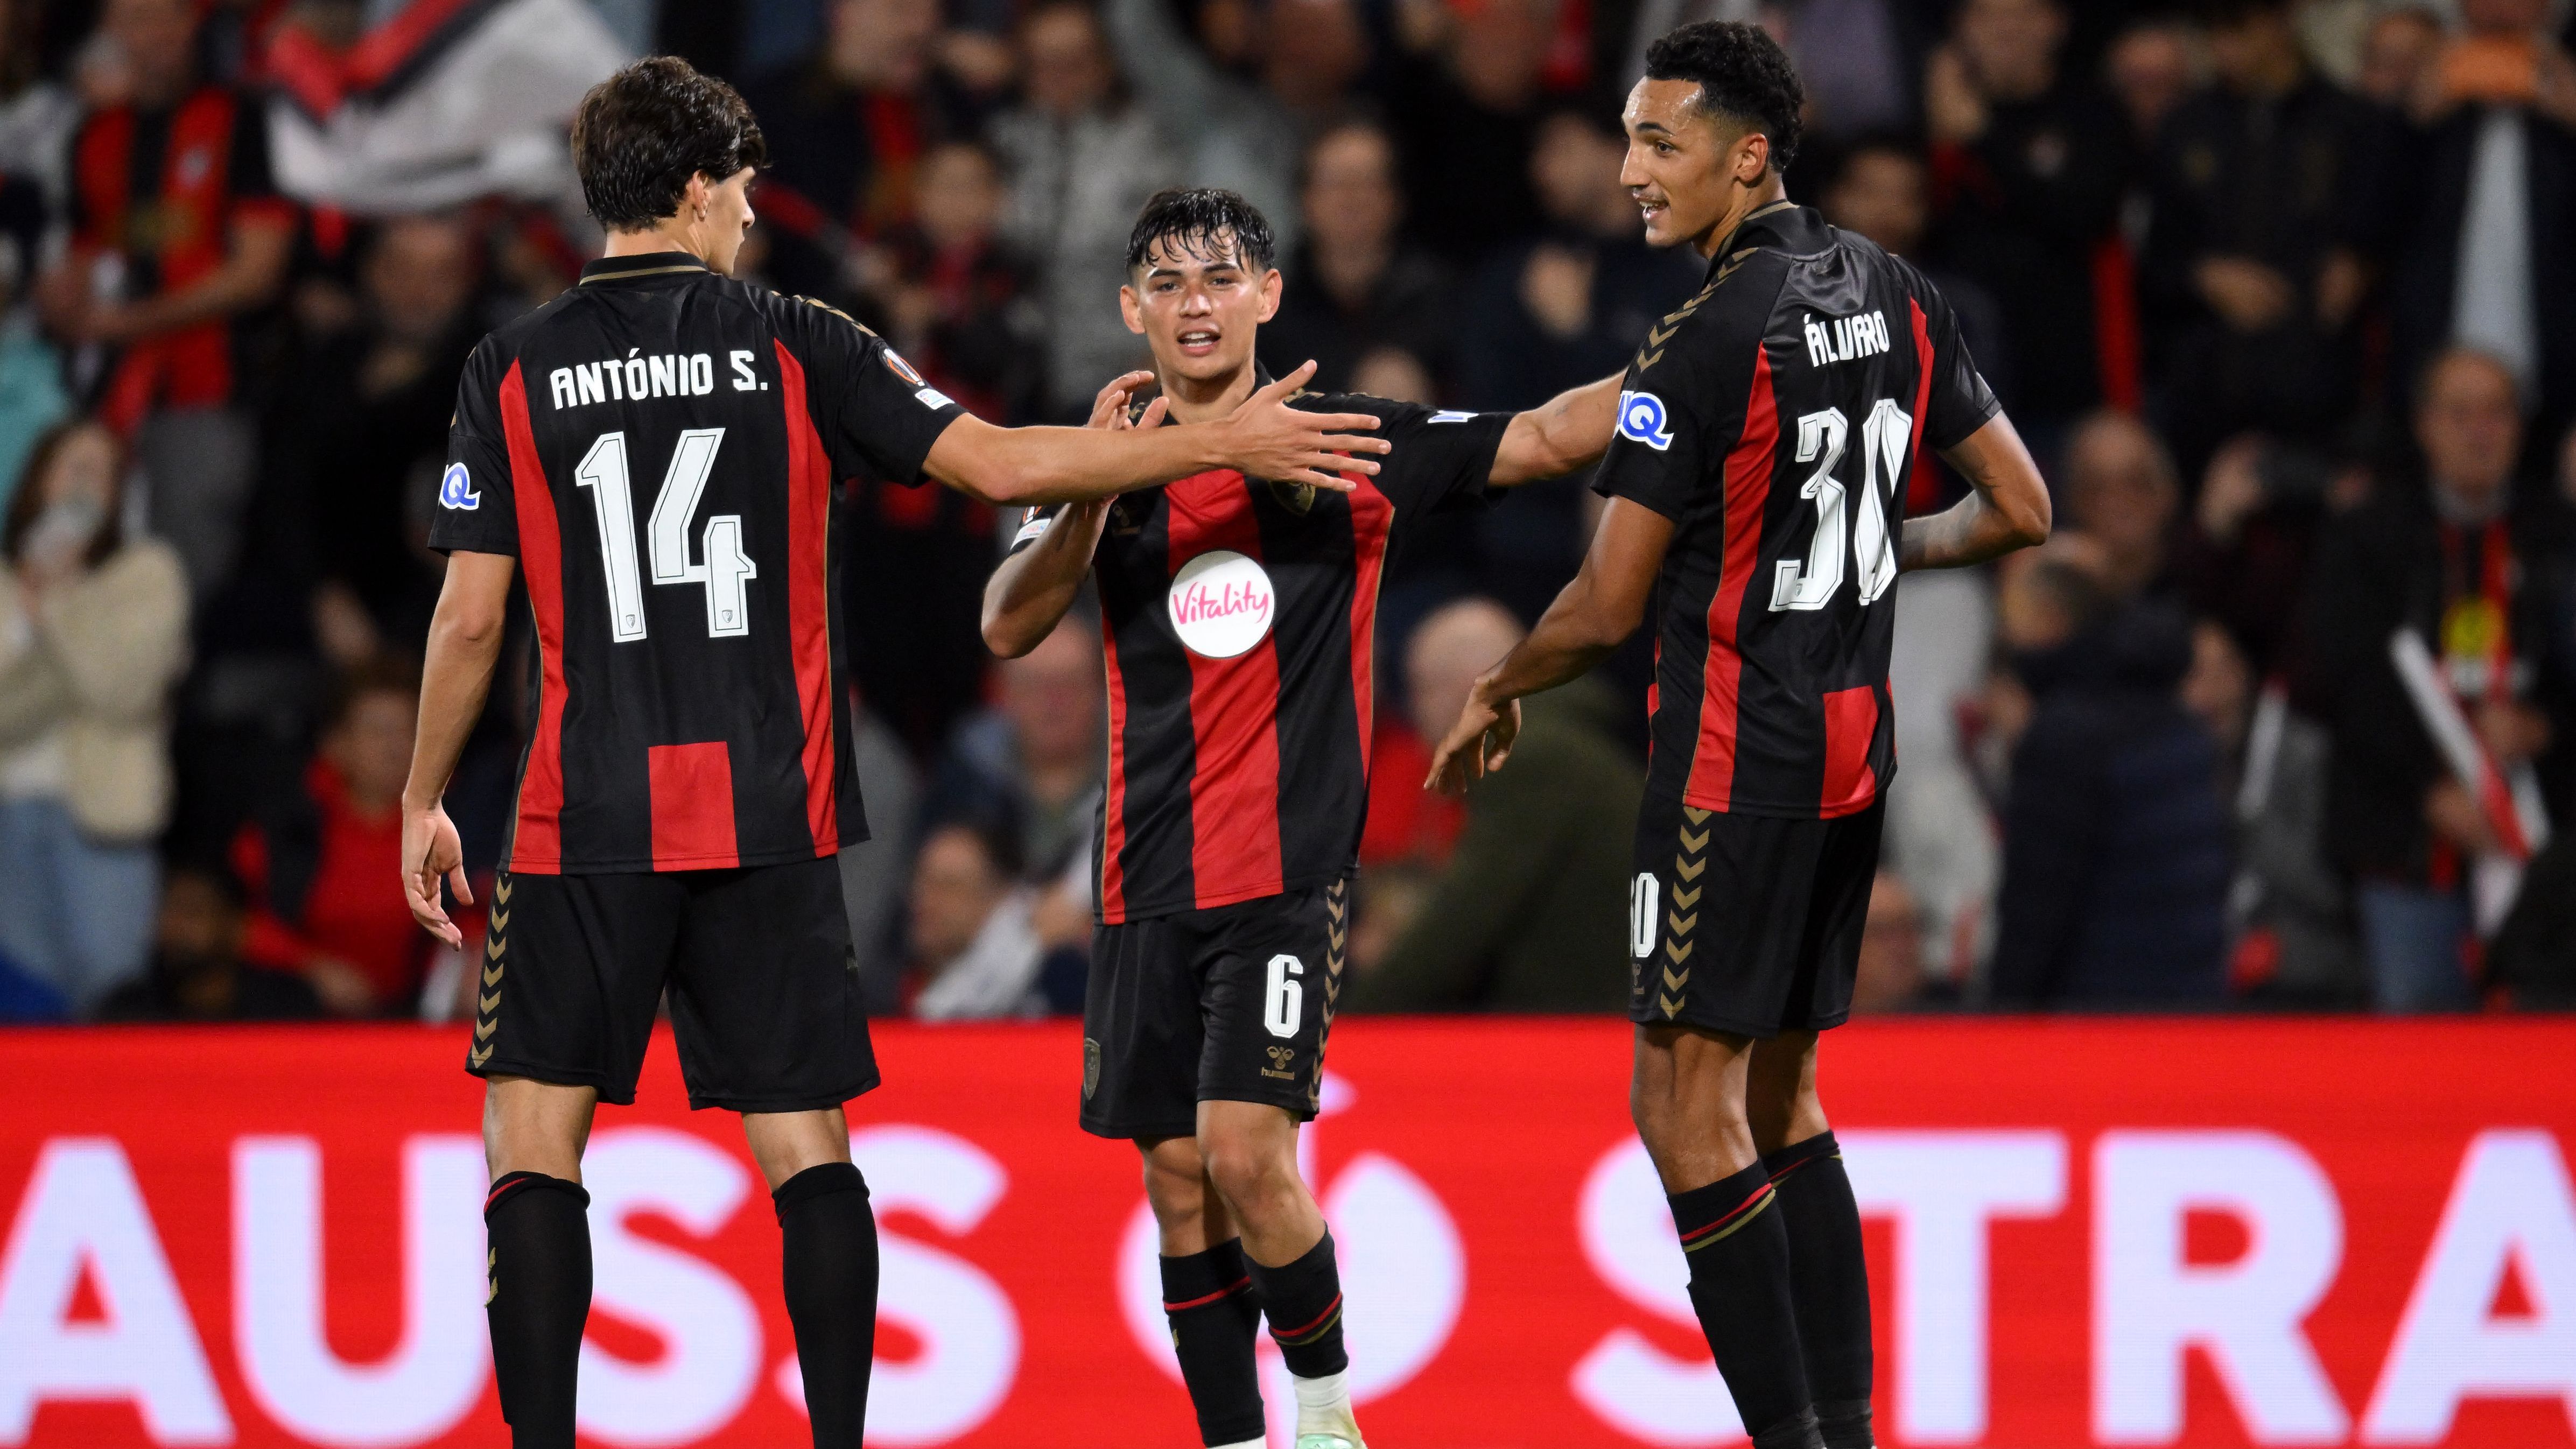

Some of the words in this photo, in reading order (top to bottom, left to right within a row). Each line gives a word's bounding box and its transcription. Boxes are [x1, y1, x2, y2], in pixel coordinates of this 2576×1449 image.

[550, 348, 714, 410] ANTÓNIO
[729, 350, 768, 391] S.
[1803, 311, 1890, 368] ÁLVARO
[574, 427, 757, 643] 14
[1768, 398, 1912, 610] 30
[1173, 580, 1269, 624] Vitality
[1630, 873, 1659, 958] 0
[1265, 954, 1303, 1038] 6
[0, 1125, 1021, 1448] AUSS
